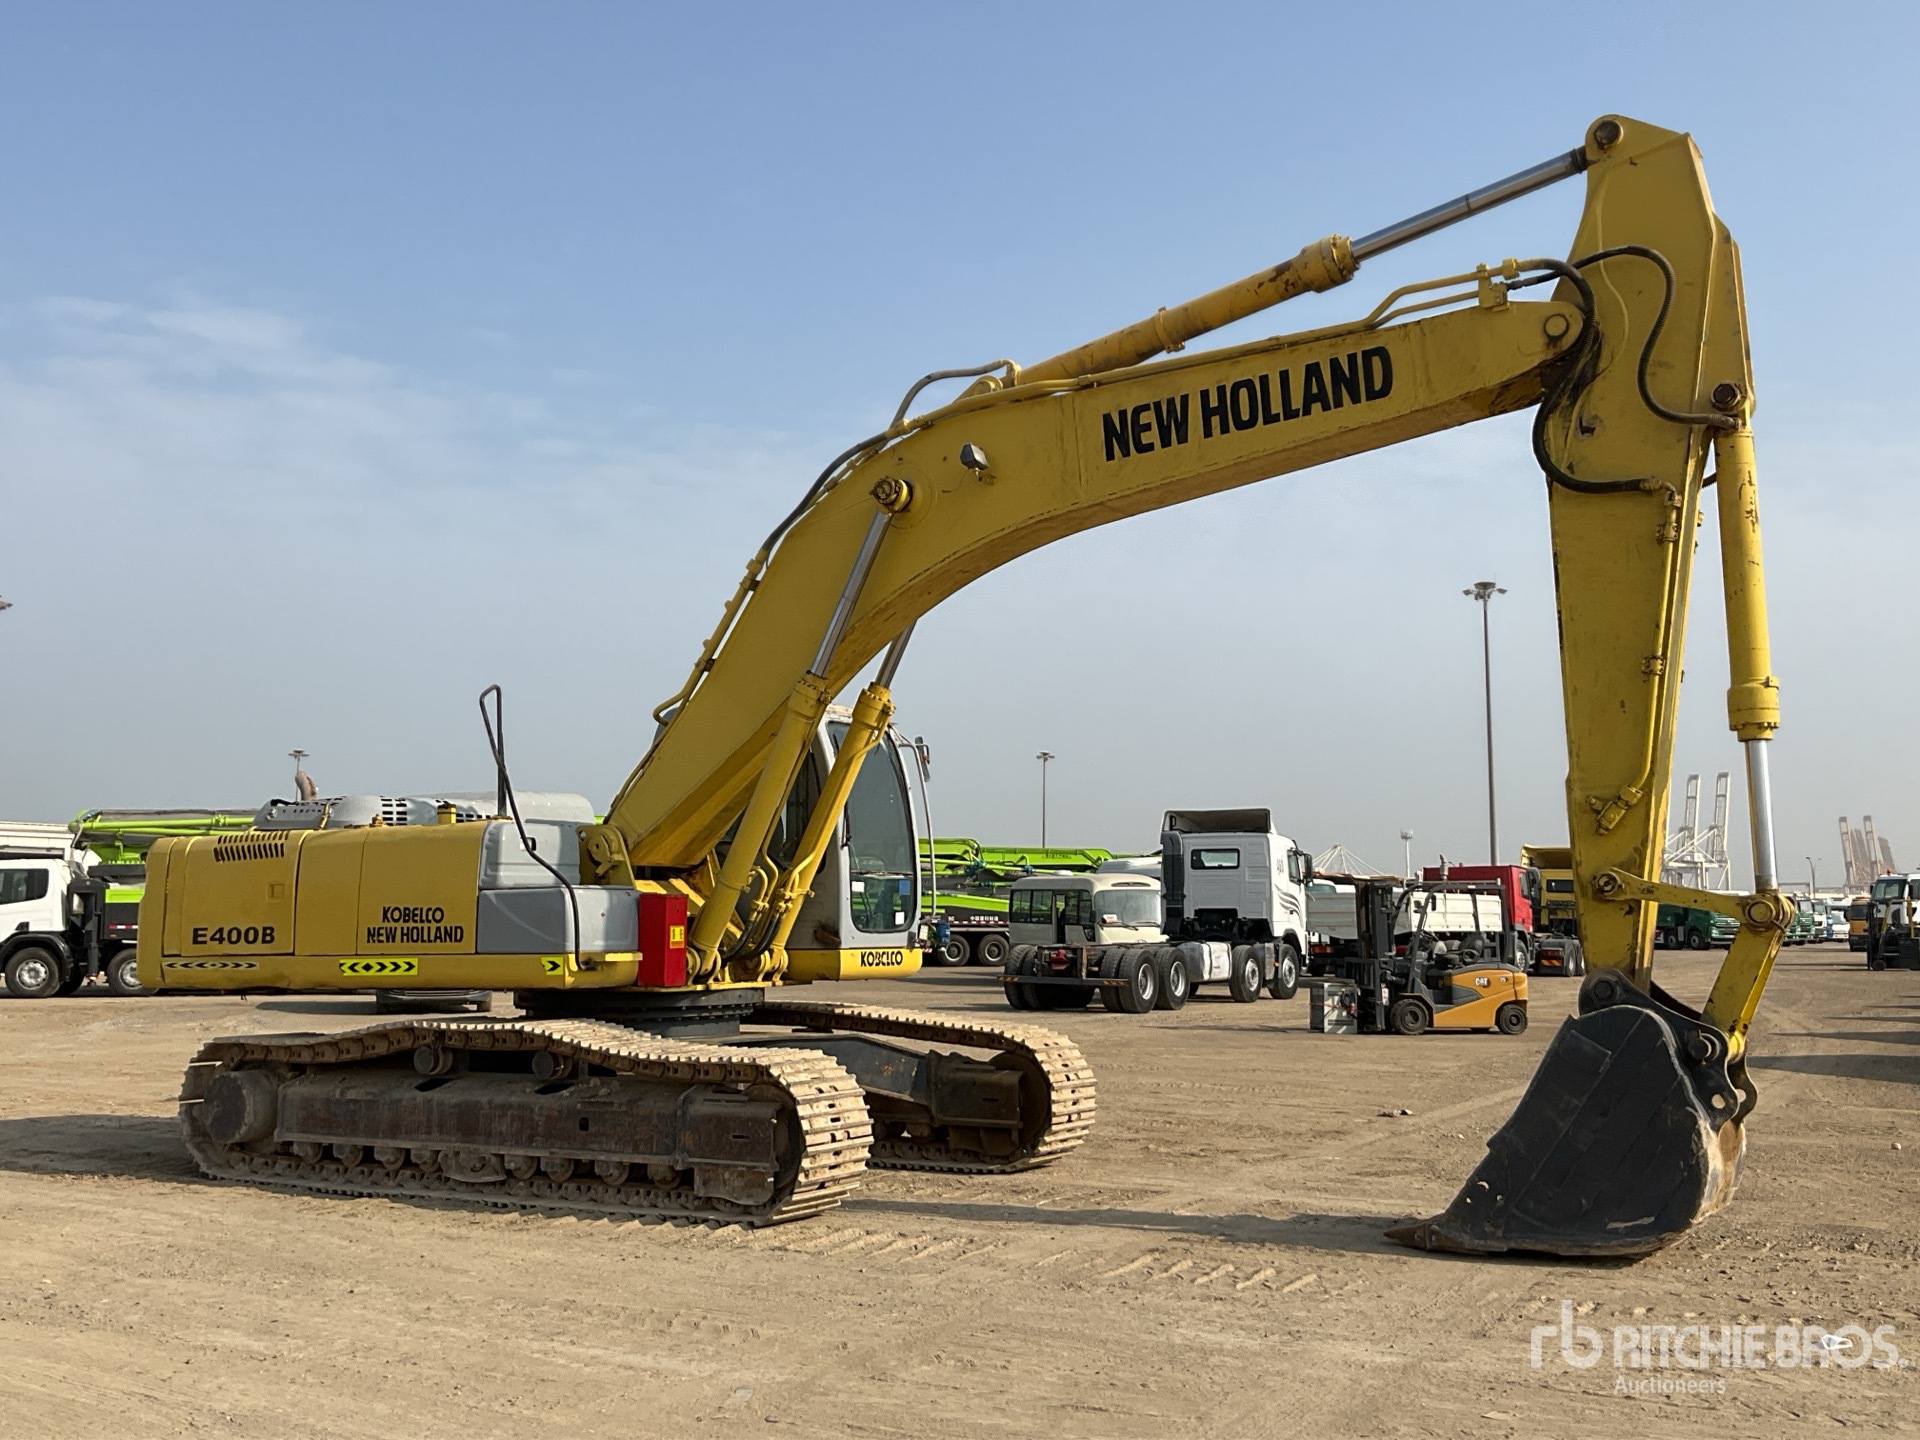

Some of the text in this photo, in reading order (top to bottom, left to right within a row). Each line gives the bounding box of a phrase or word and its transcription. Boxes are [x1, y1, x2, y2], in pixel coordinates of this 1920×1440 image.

[1102, 346, 1393, 462] NEW HOLLAND
[382, 906, 445, 923] KOBELCO
[192, 926, 275, 945] E400B
[366, 926, 464, 944] NEW HOLLAND
[1475, 977, 1488, 986] CAT
